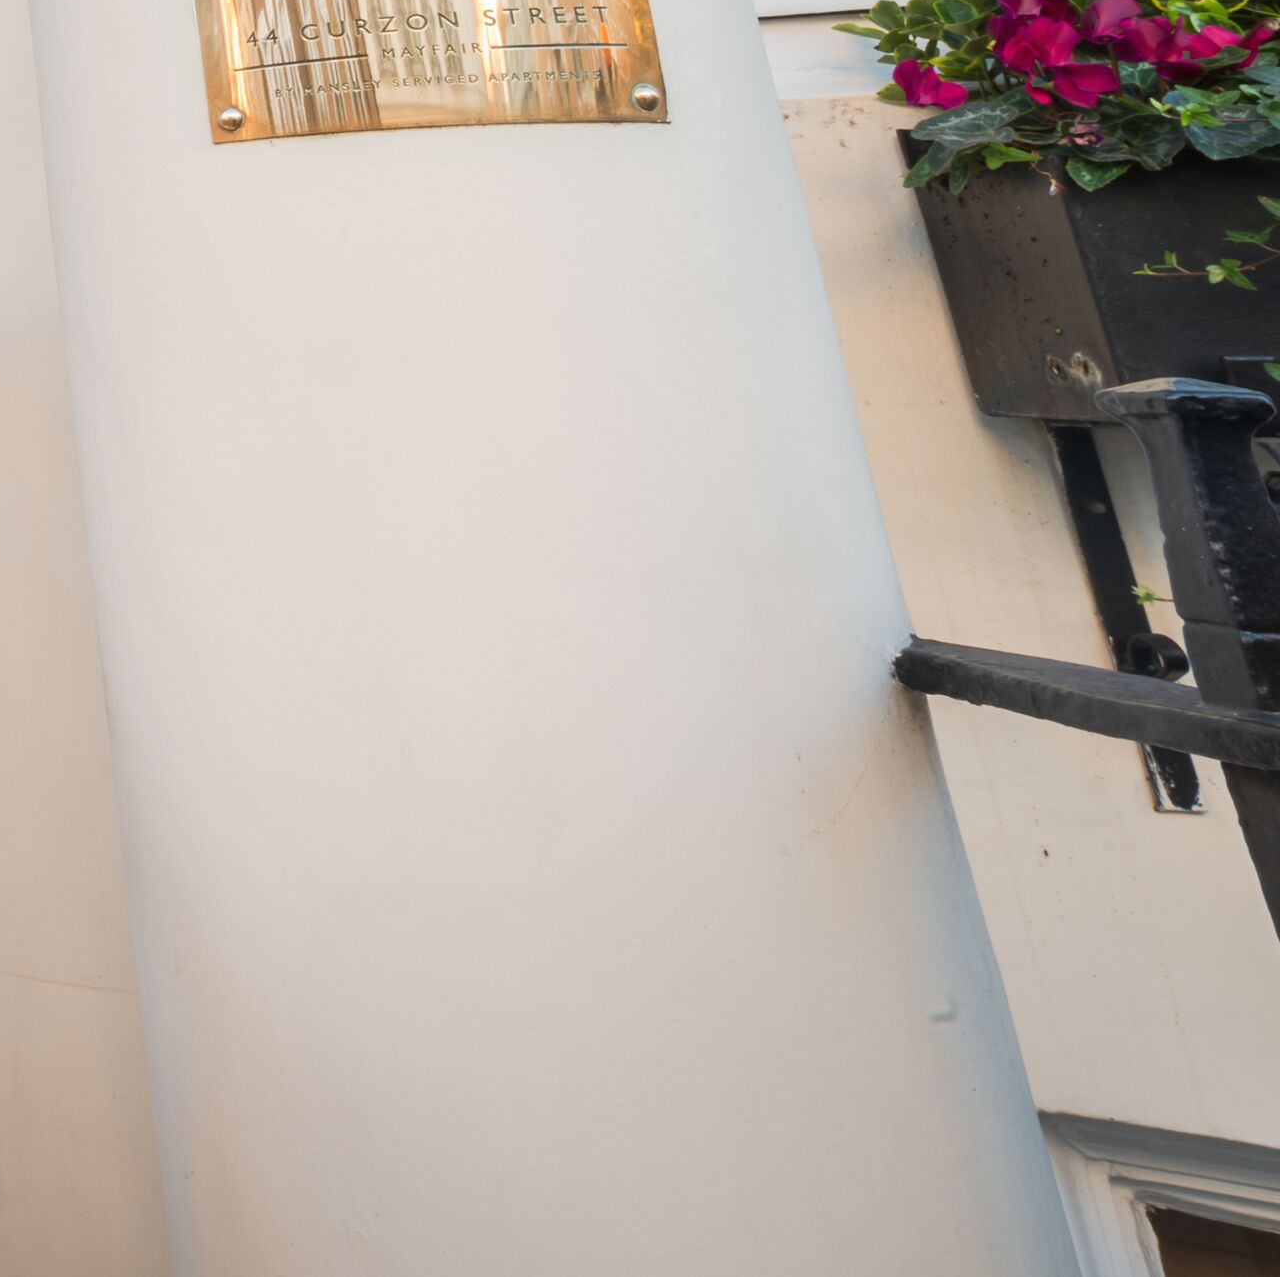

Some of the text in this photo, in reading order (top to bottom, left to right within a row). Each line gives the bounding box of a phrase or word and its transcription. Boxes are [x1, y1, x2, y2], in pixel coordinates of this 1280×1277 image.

[246, 5, 608, 48] 44 CURZON STREET
[381, 42, 484, 60] MAYFAIR
[275, 70, 602, 98] BY MANSLEY SERVICED APARTMENTS
